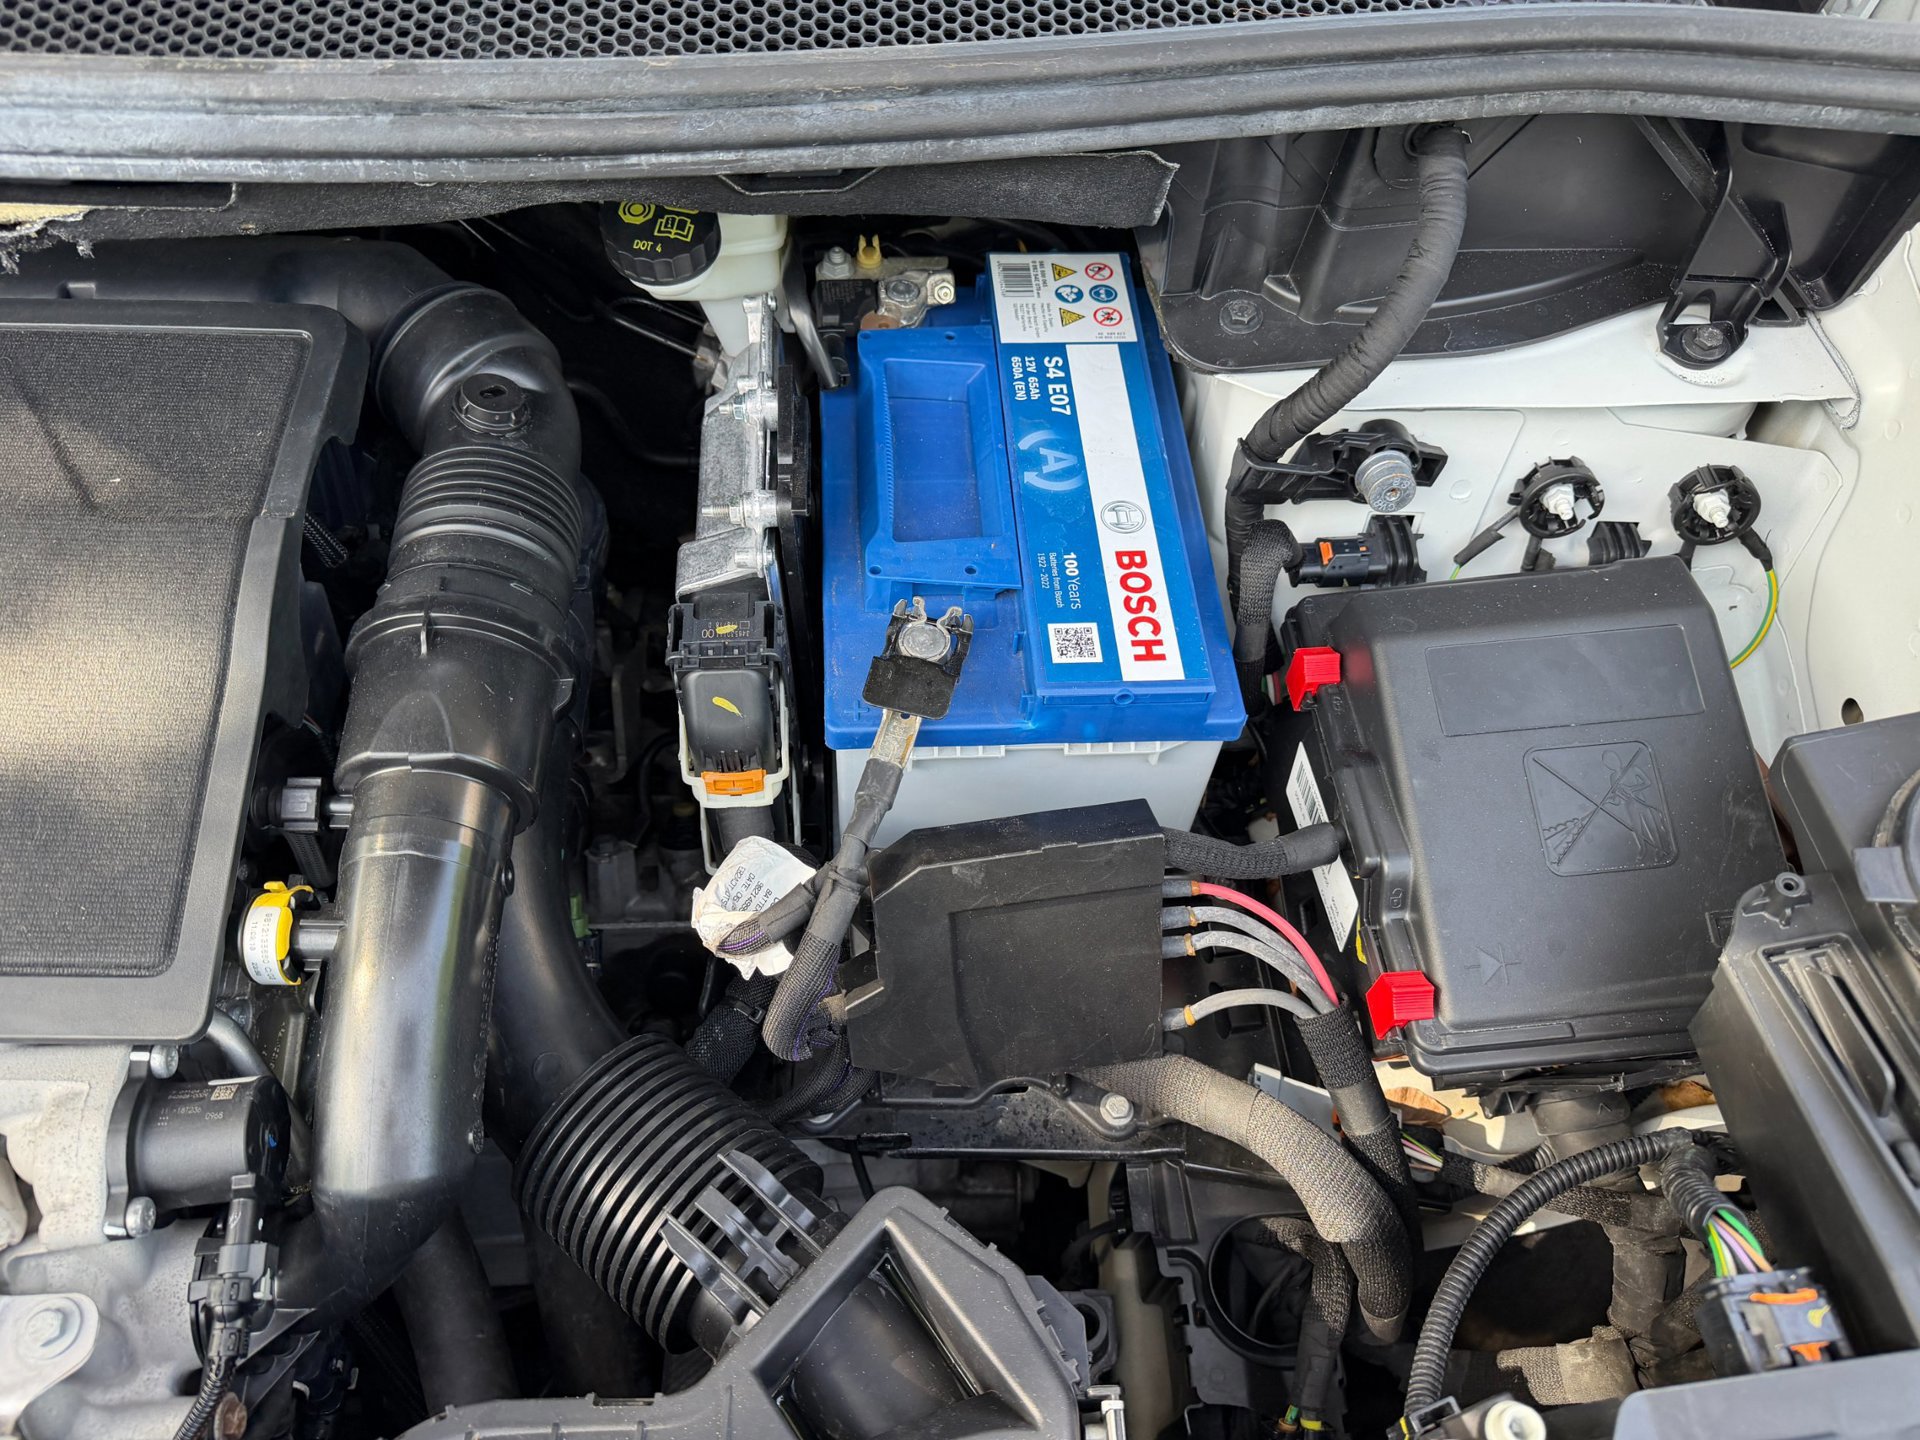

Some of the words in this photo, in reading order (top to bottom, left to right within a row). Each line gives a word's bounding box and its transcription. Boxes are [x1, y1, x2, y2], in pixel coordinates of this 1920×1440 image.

[633, 239, 654, 251] DOT
[656, 243, 662, 252] 4
[1011, 356, 1024, 379] 650A
[1025, 356, 1037, 373] 12V
[1043, 356, 1065, 379] S4
[1013, 381, 1027, 401] (EN)
[1028, 377, 1041, 400] 65Ah
[1048, 384, 1071, 416] E07
[1037, 552, 1047, 567] 1922
[1049, 552, 1058, 577] Batteries
[1063, 552, 1079, 577] 100
[1041, 573, 1050, 589] 2022
[1053, 577, 1061, 591] from
[1055, 591, 1065, 608] Bosch
[1067, 577, 1082, 610] Years
[1115, 550, 1167, 661] BOSCH
[741, 872, 756, 891] DATE
